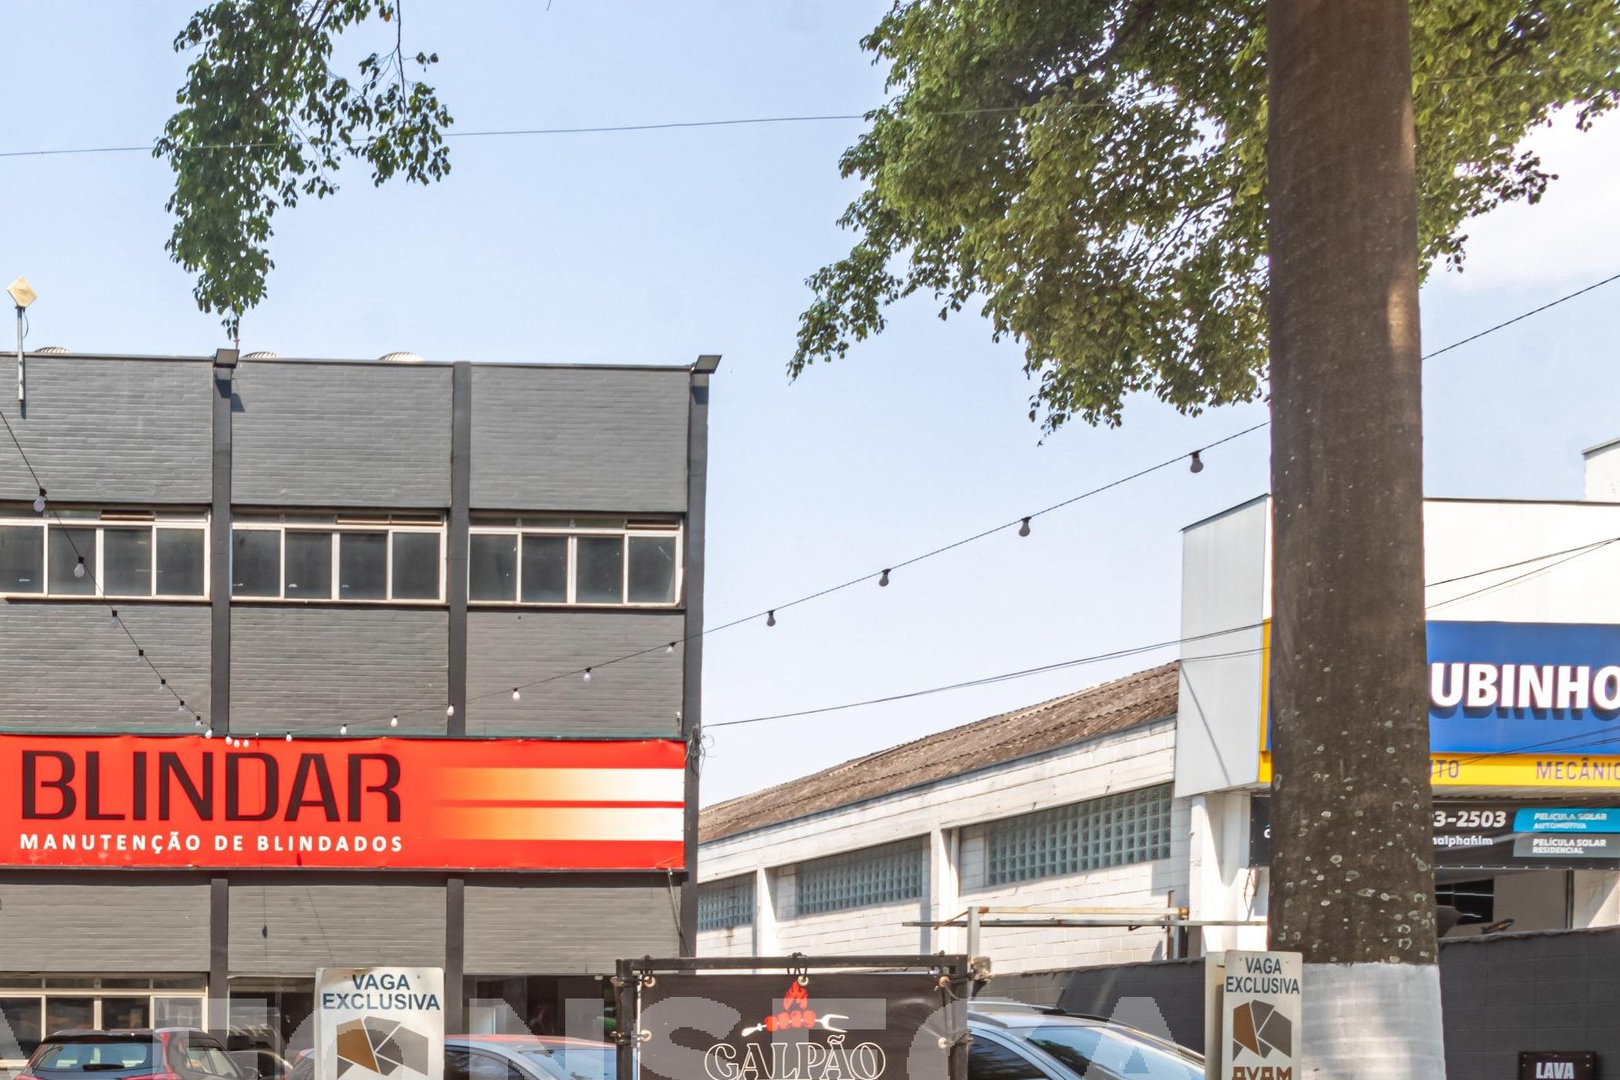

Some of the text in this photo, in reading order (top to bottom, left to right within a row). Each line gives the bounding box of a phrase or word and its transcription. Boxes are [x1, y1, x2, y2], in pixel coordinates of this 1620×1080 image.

[21, 750, 402, 823] BLINDAR
[1432, 811, 1507, 828] 3-2503
[20, 832, 403, 854] MANUTENÇÃO DE BLINDADOS
[1245, 957, 1282, 975] VAGA
[352, 974, 411, 990] VAGA
[1225, 976, 1300, 994] EXCLUSIVA
[323, 993, 440, 1010] EXCLUSIVA
[1536, 1062, 1574, 1079] LAVA
